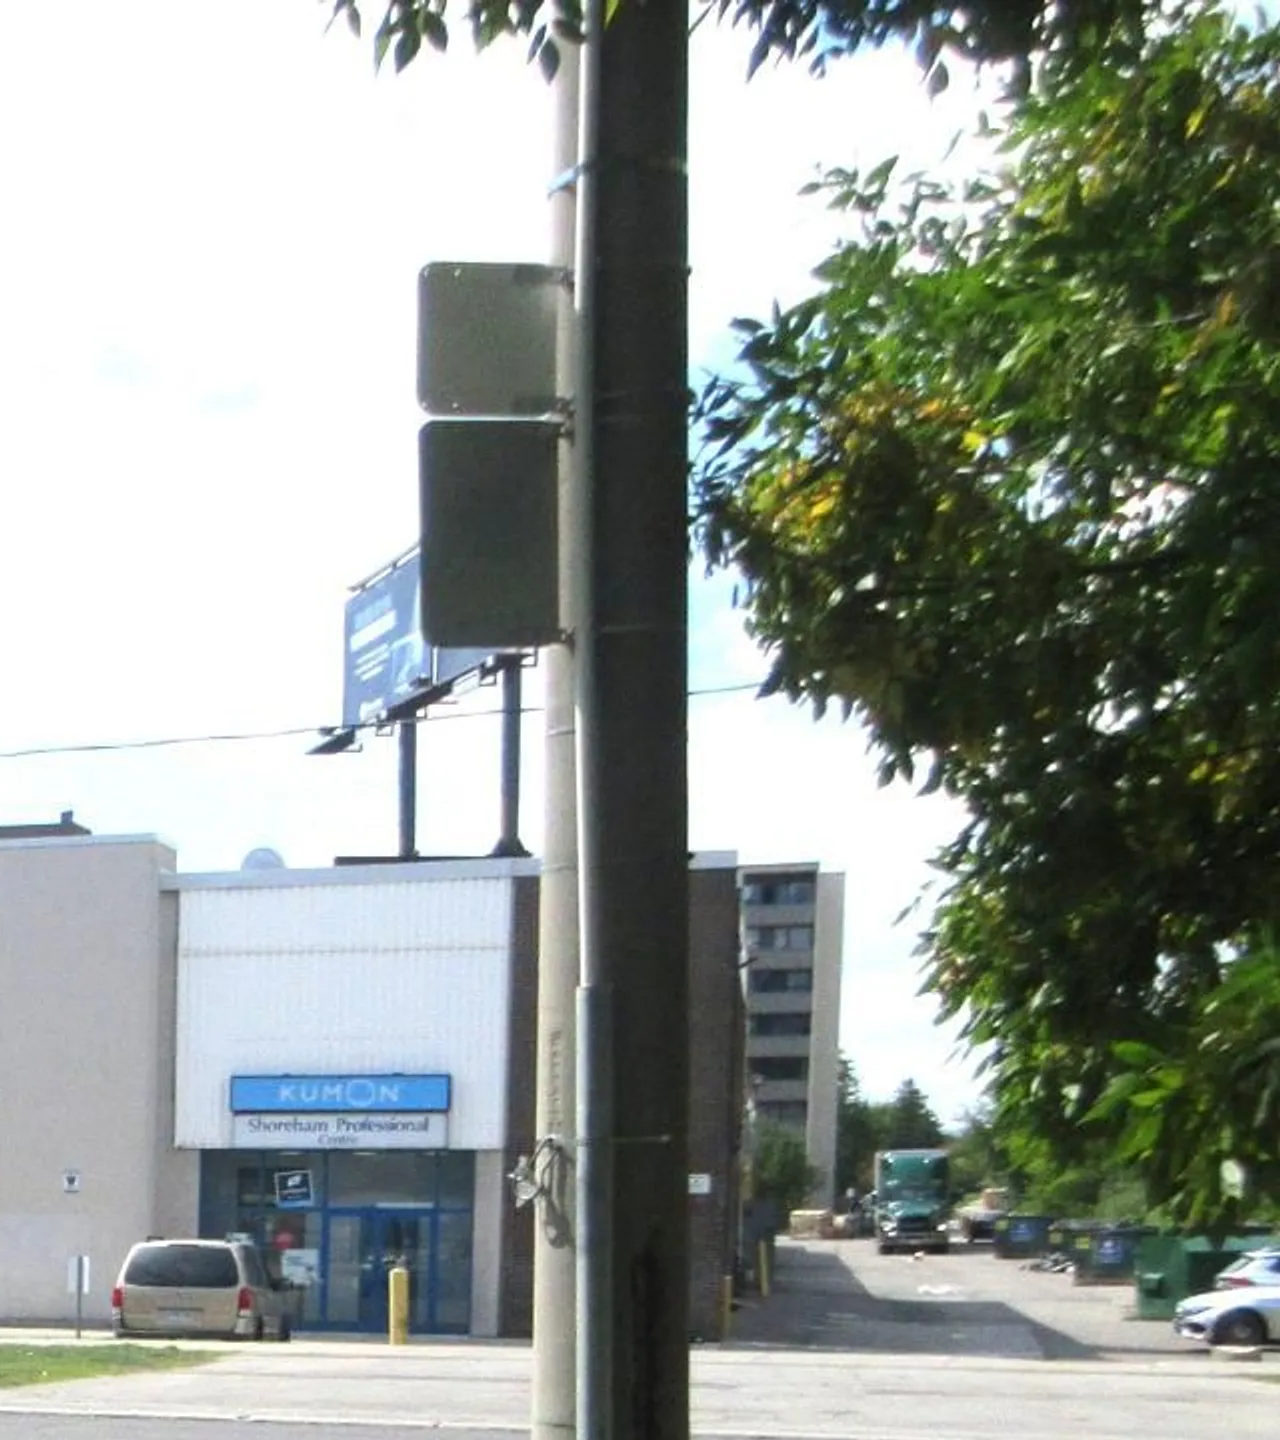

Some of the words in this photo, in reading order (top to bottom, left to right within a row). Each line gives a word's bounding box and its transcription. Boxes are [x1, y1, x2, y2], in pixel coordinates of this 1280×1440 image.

[279, 1079, 400, 1107] KUMON
[247, 1117, 329, 1134] Shoreham
[337, 1115, 430, 1133] Professional
[317, 1133, 358, 1145] Centre
